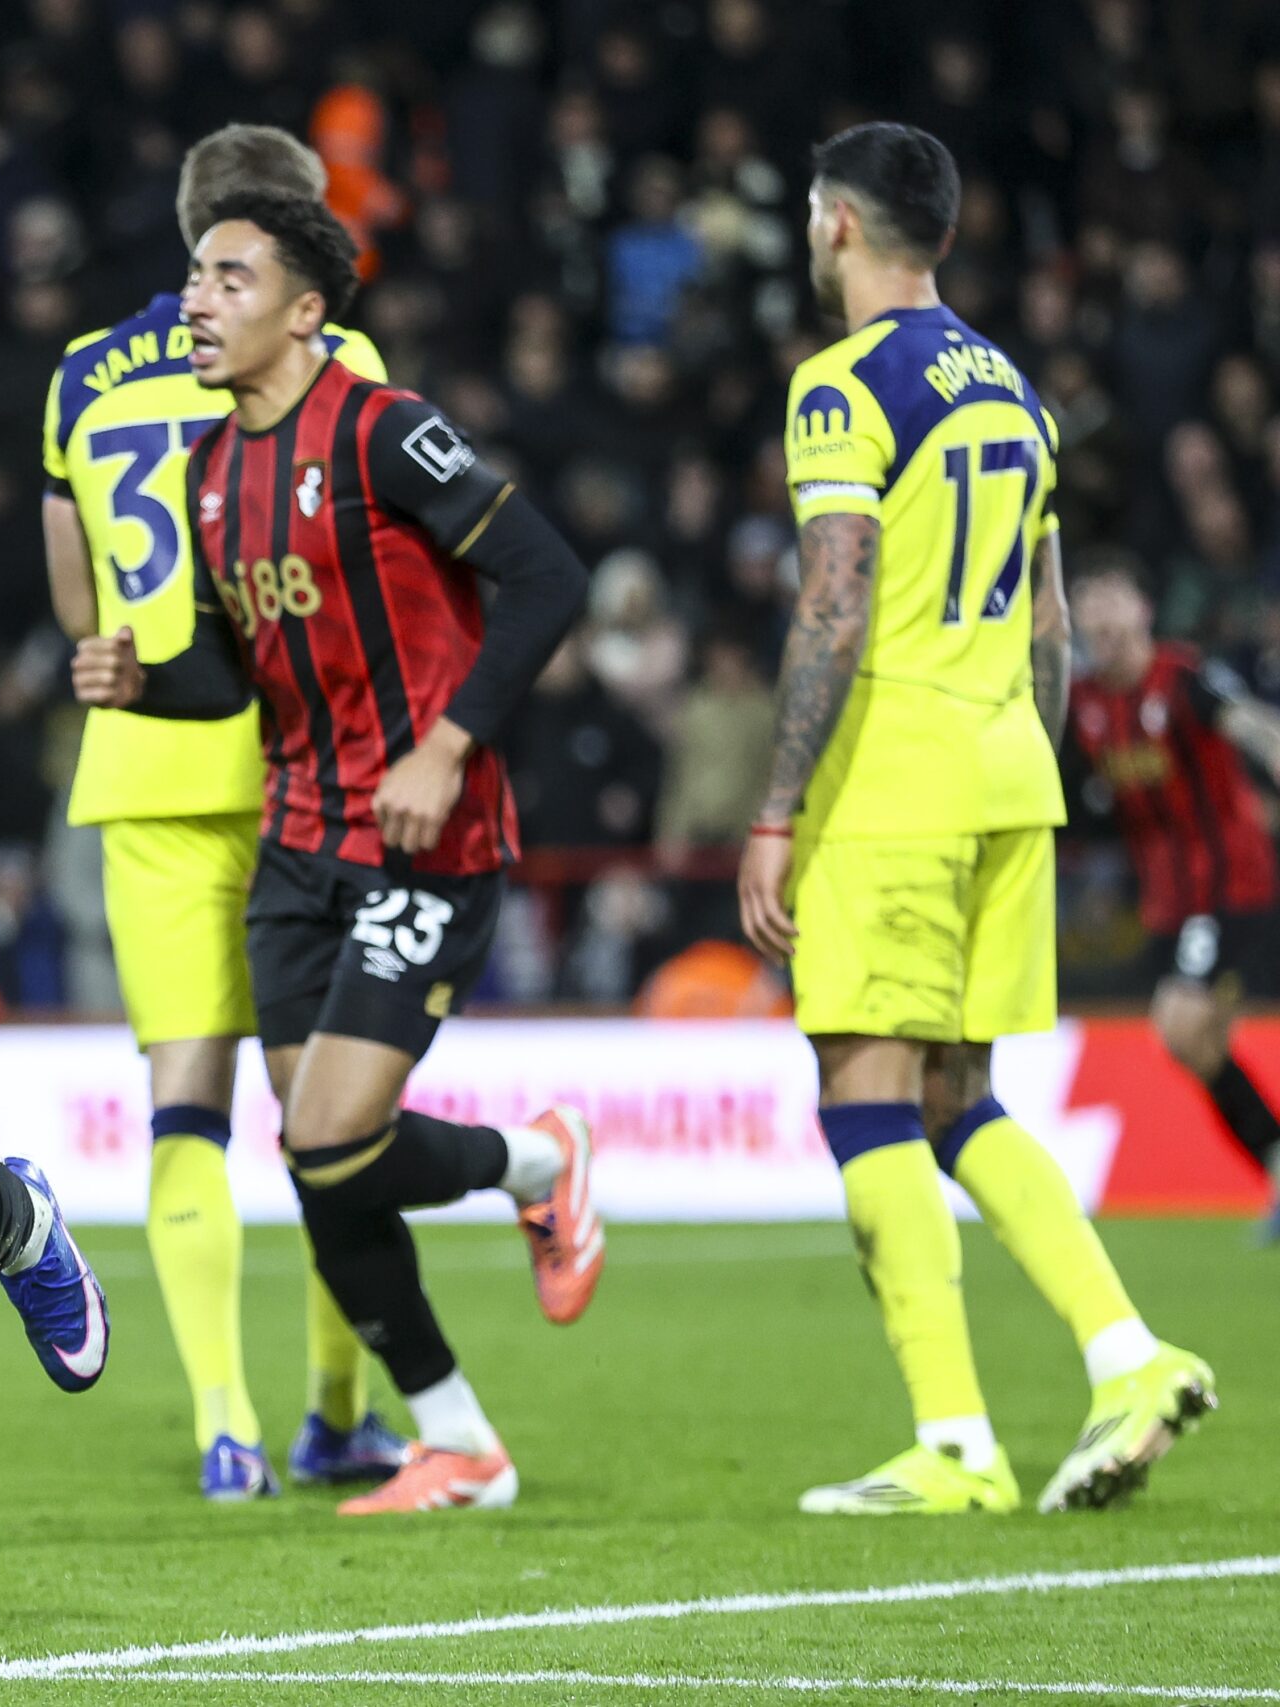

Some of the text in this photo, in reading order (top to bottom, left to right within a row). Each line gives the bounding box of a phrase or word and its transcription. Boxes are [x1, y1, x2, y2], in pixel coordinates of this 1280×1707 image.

[83, 324, 194, 394] VAN D
[923, 344, 1025, 404] ROMERO
[86, 416, 226, 603] 3
[941, 438, 1040, 627] 17
[351, 887, 454, 966] 23
